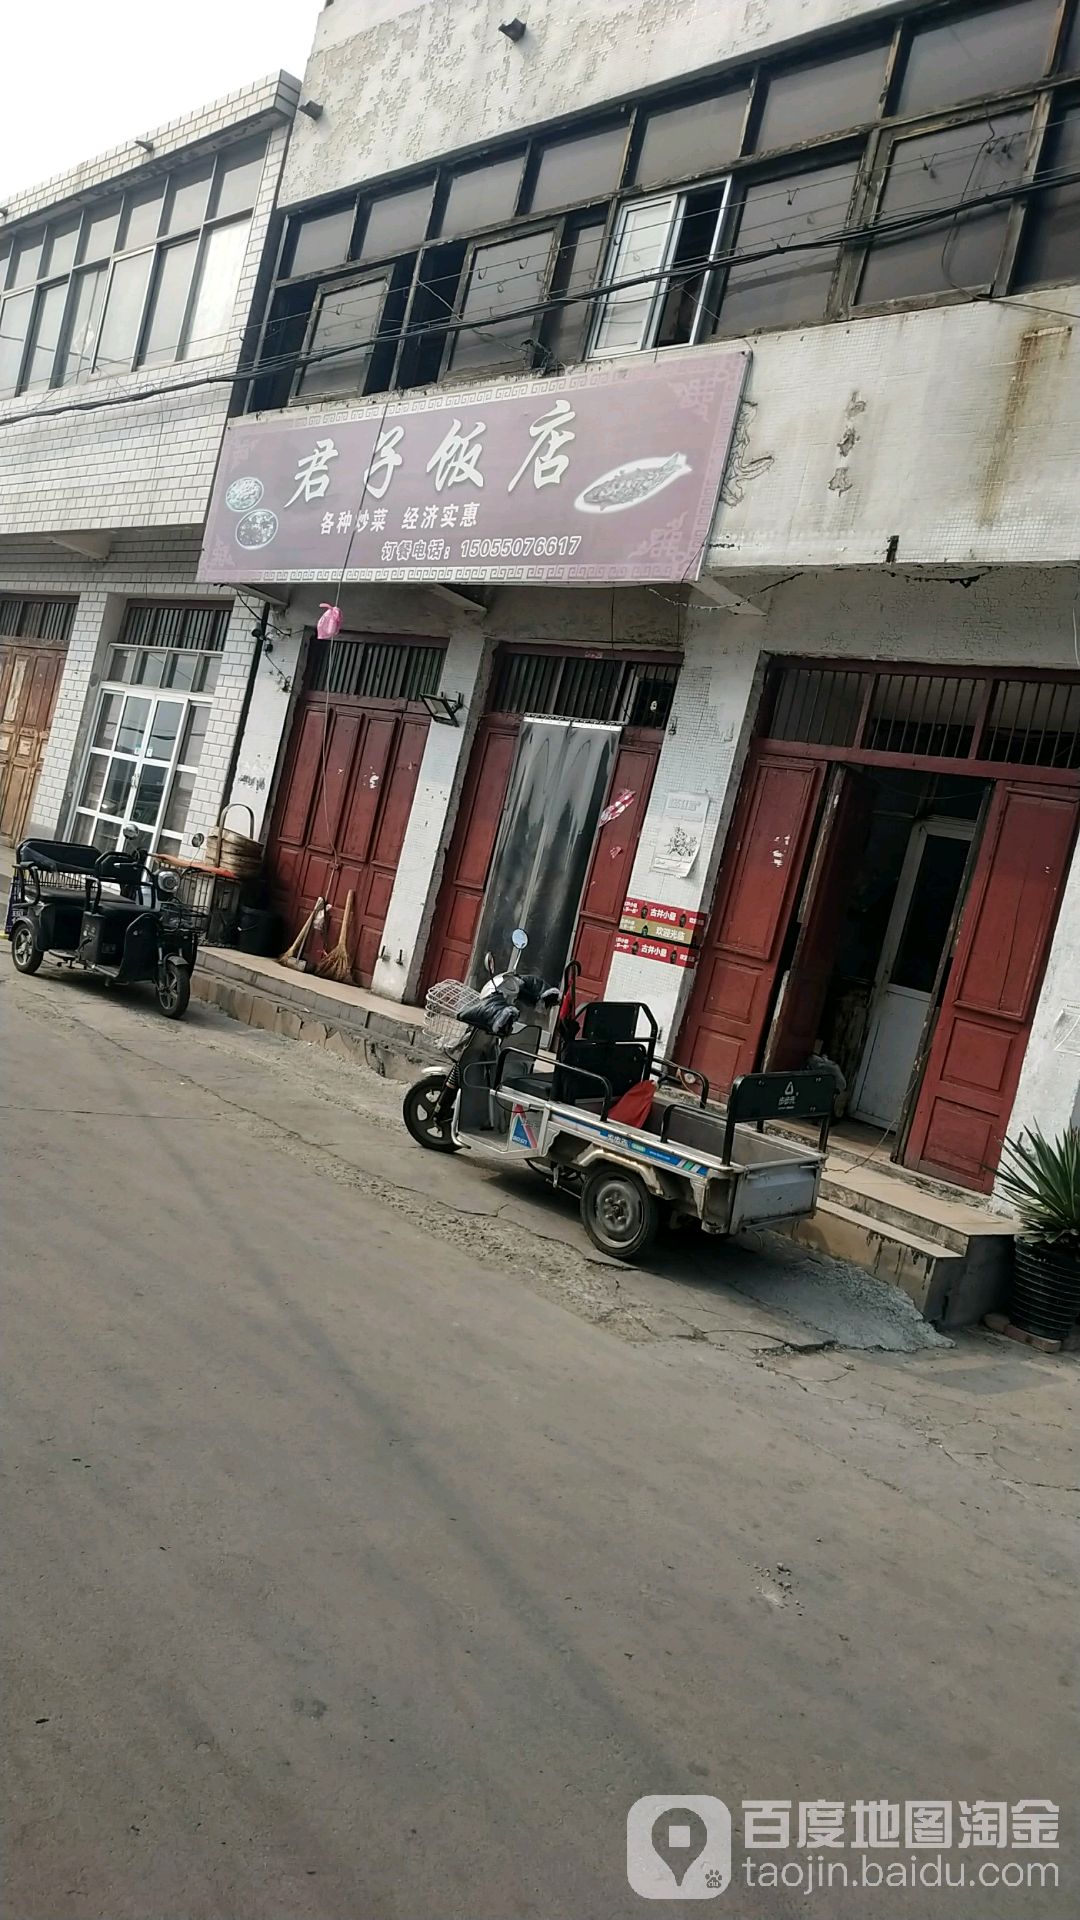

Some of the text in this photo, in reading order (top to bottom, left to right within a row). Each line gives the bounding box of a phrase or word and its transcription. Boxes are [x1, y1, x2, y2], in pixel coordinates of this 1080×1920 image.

[283, 400, 576, 508] 君子饭店
[320, 502, 481, 535] 各种炒菜 经济实惠
